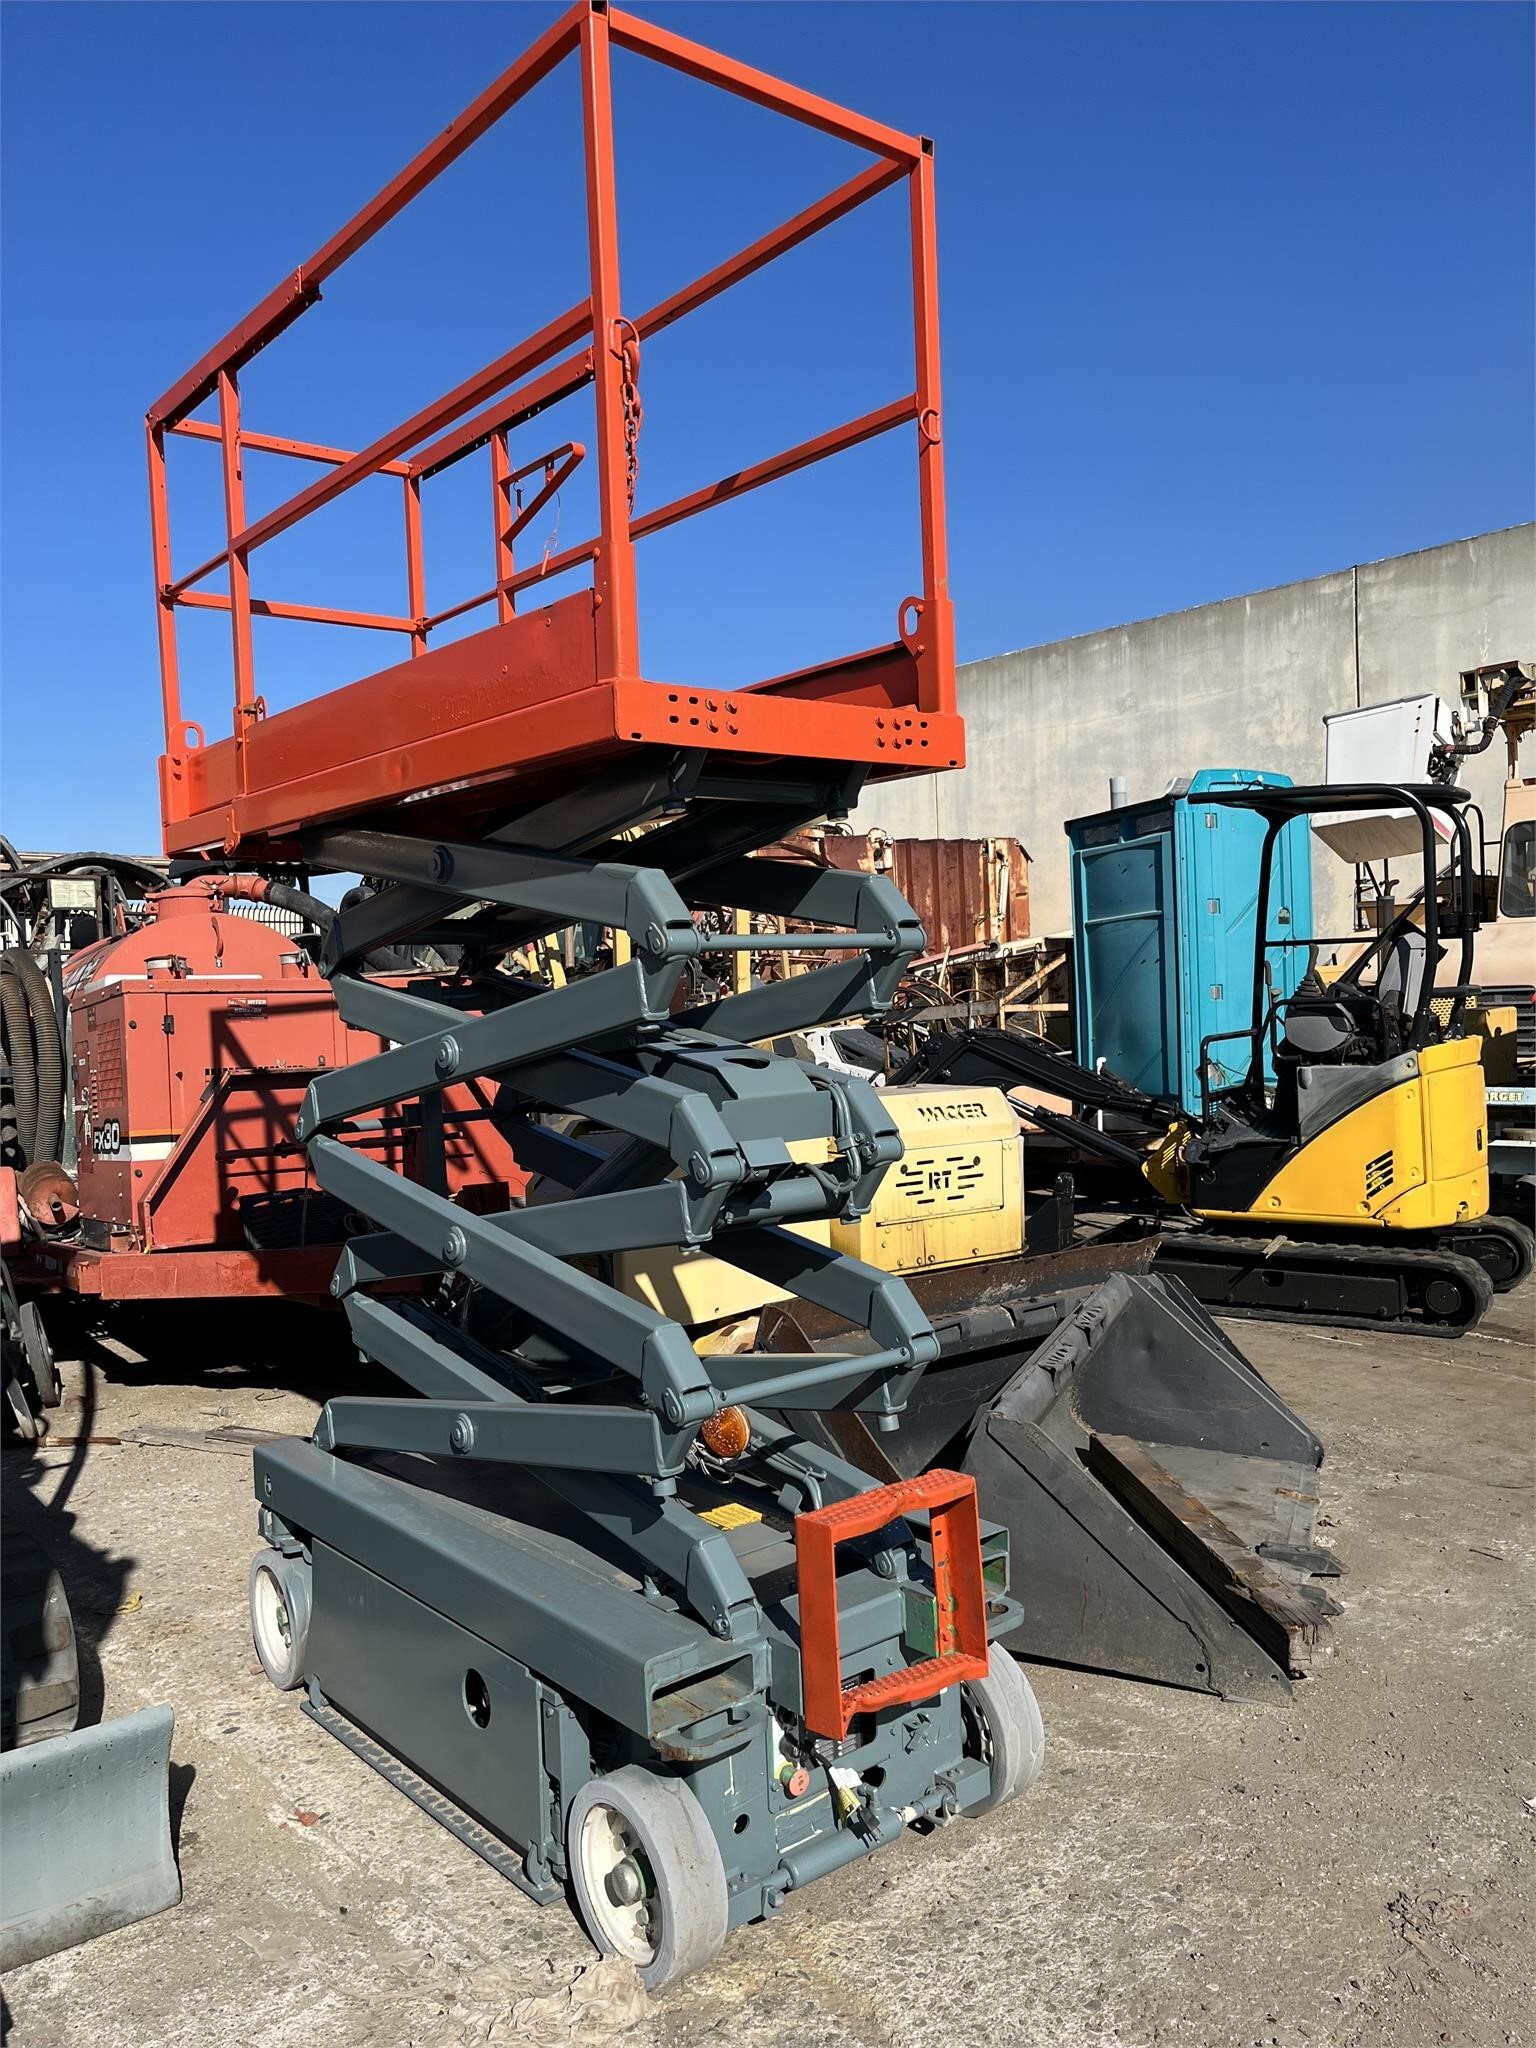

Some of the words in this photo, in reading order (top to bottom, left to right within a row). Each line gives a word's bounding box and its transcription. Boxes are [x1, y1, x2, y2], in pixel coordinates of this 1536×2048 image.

[917, 1103, 987, 1122] WACKER
[93, 1121, 120, 1151] FX30
[928, 1170, 952, 1190] RT
